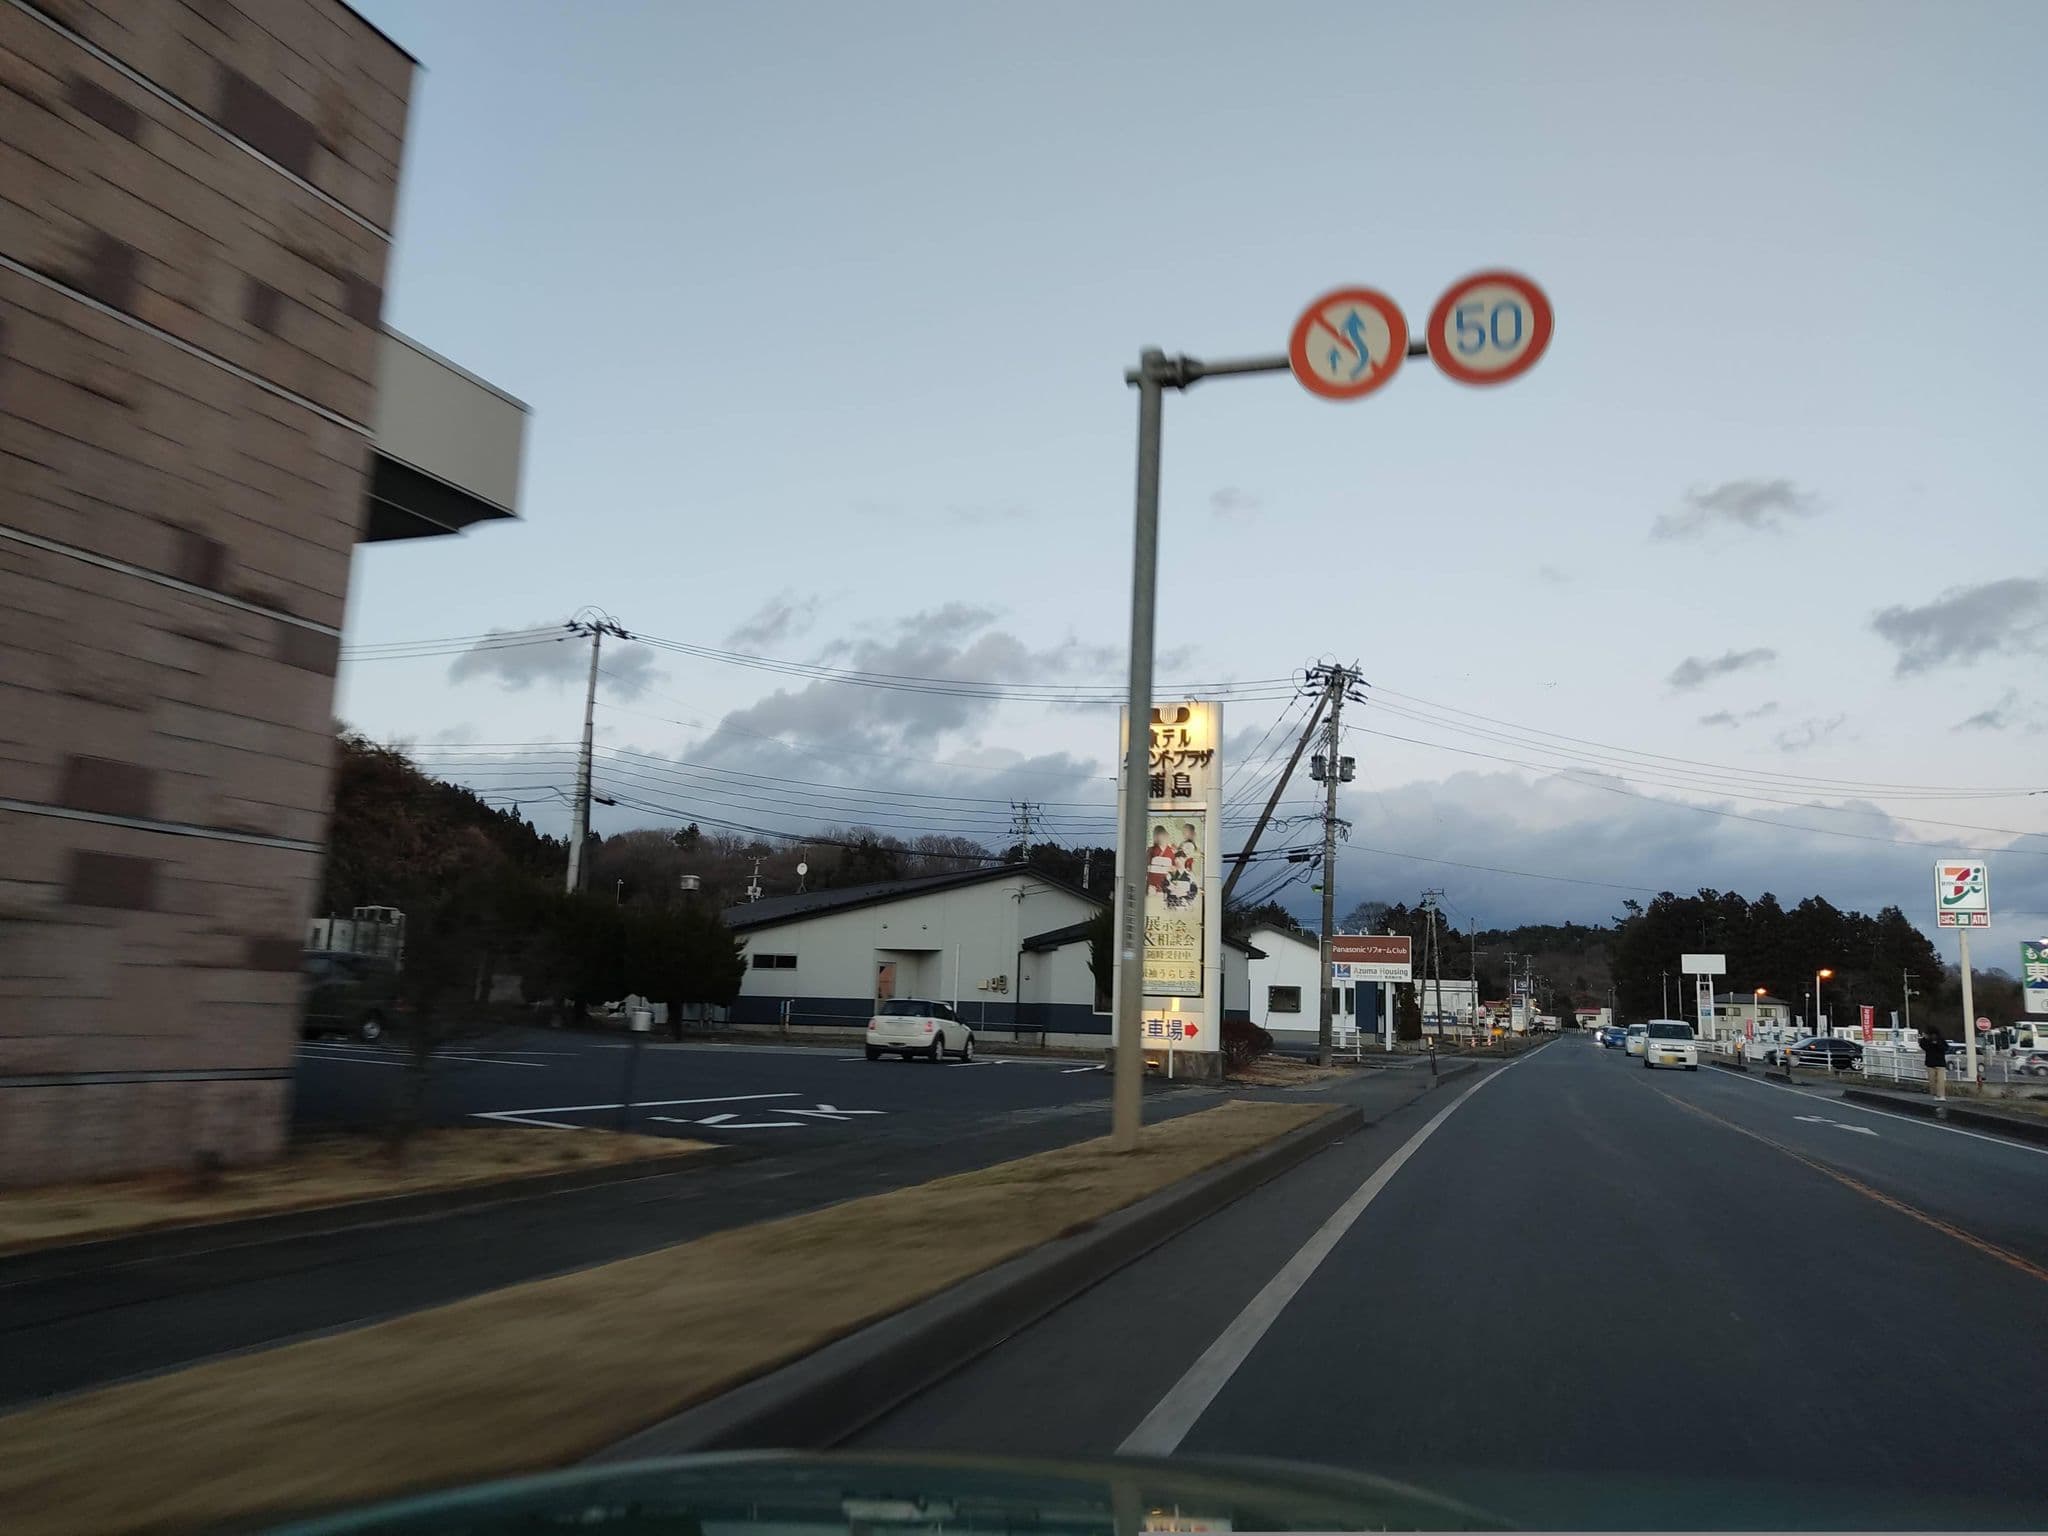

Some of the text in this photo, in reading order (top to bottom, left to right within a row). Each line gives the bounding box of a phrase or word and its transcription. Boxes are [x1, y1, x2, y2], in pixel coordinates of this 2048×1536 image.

[1456, 300, 1522, 356] 50
[1332, 945, 1366, 954] Panasonic
[1353, 967, 1378, 975] Azuma
[1141, 1019, 1183, 1041] 車場
